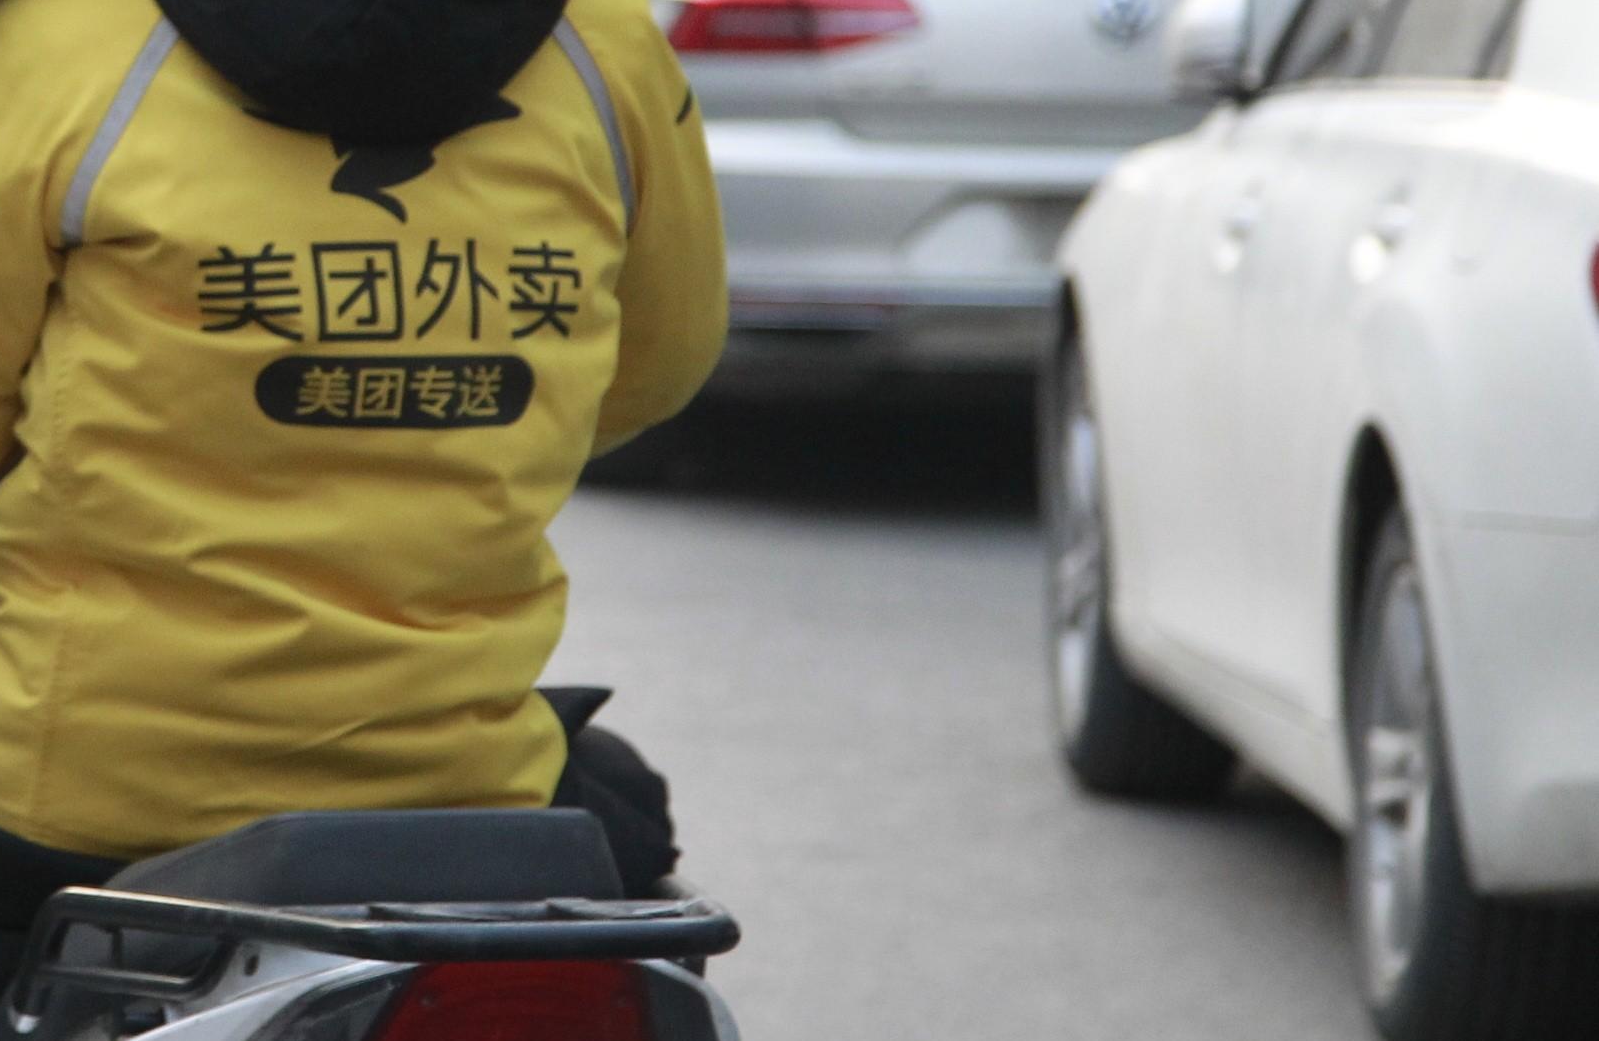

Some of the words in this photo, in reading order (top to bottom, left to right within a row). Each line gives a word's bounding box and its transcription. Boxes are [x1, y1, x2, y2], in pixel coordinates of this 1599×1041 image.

[198, 238, 581, 342] 美团外卖
[295, 365, 502, 419] 美团专送
